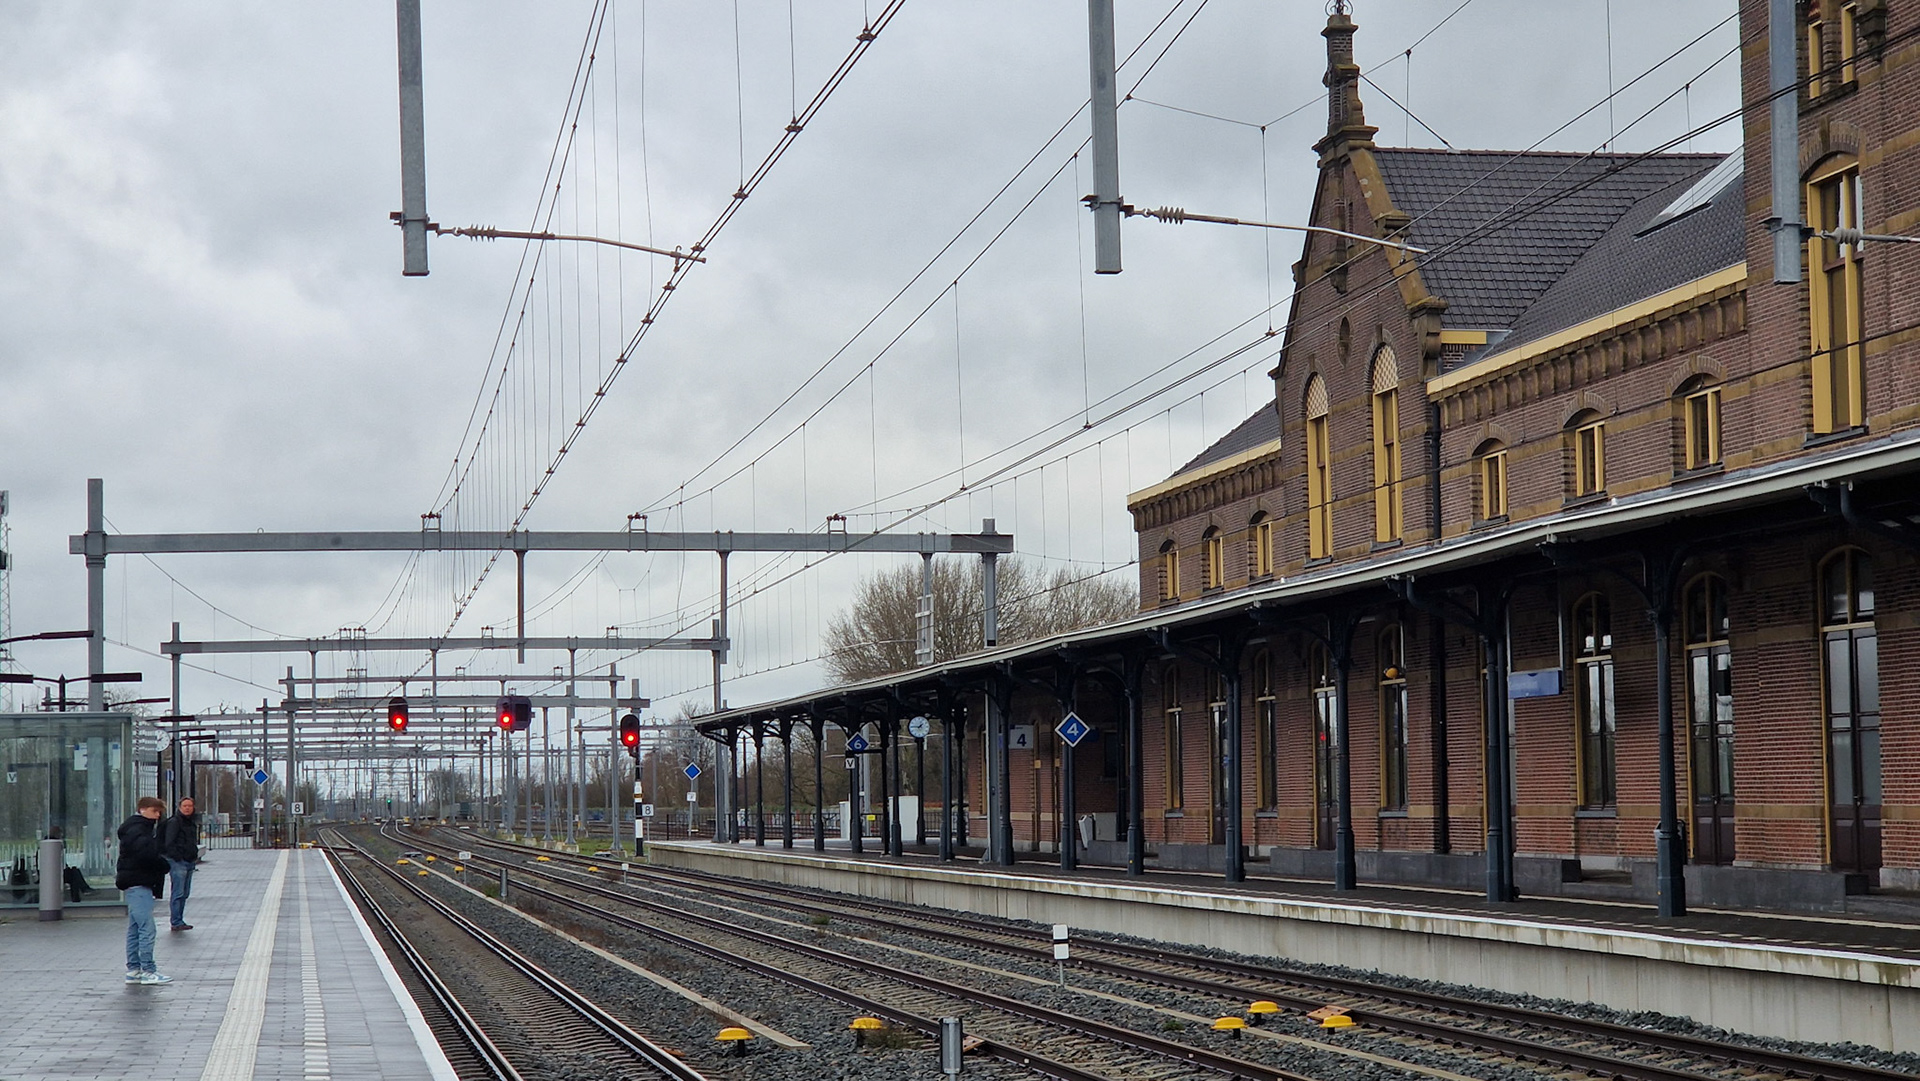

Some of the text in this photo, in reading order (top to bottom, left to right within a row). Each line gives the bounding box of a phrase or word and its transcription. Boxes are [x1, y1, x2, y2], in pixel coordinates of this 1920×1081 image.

[1067, 723, 1078, 736] 4
[854, 740, 862, 749] 6
[1017, 734, 1027, 747] 4
[846, 759, 854, 768] V
[8, 773, 15, 782] V
[246, 771, 253, 779] V
[295, 803, 300, 813] 8
[645, 805, 651, 815] 8
